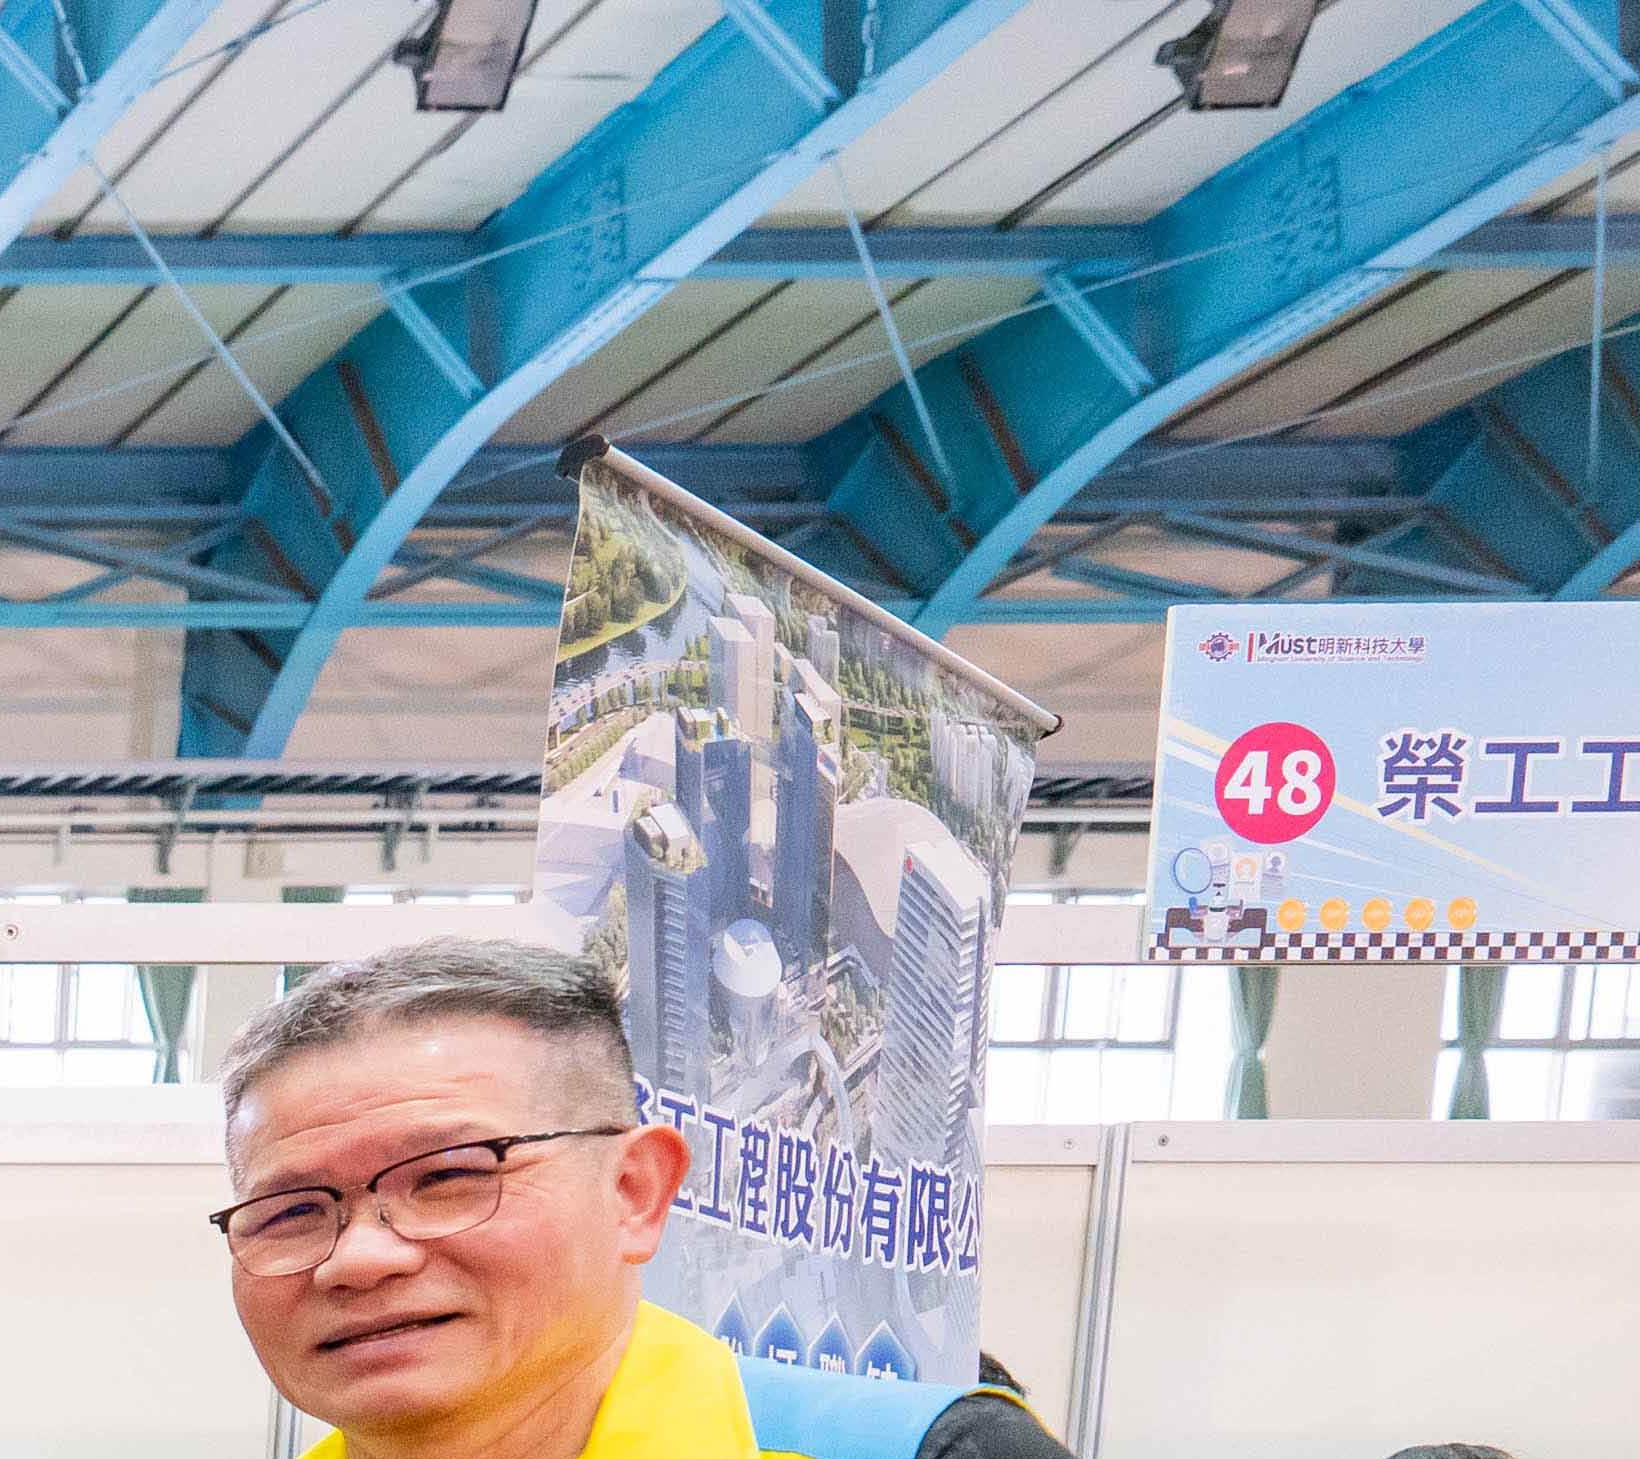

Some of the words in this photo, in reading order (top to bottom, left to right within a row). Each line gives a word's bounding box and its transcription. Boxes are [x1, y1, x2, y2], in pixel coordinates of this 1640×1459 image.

[1318, 636, 1425, 656] 明新科技大學
[1223, 749, 1323, 817] 48
[1377, 732, 1640, 820] 榮工工
